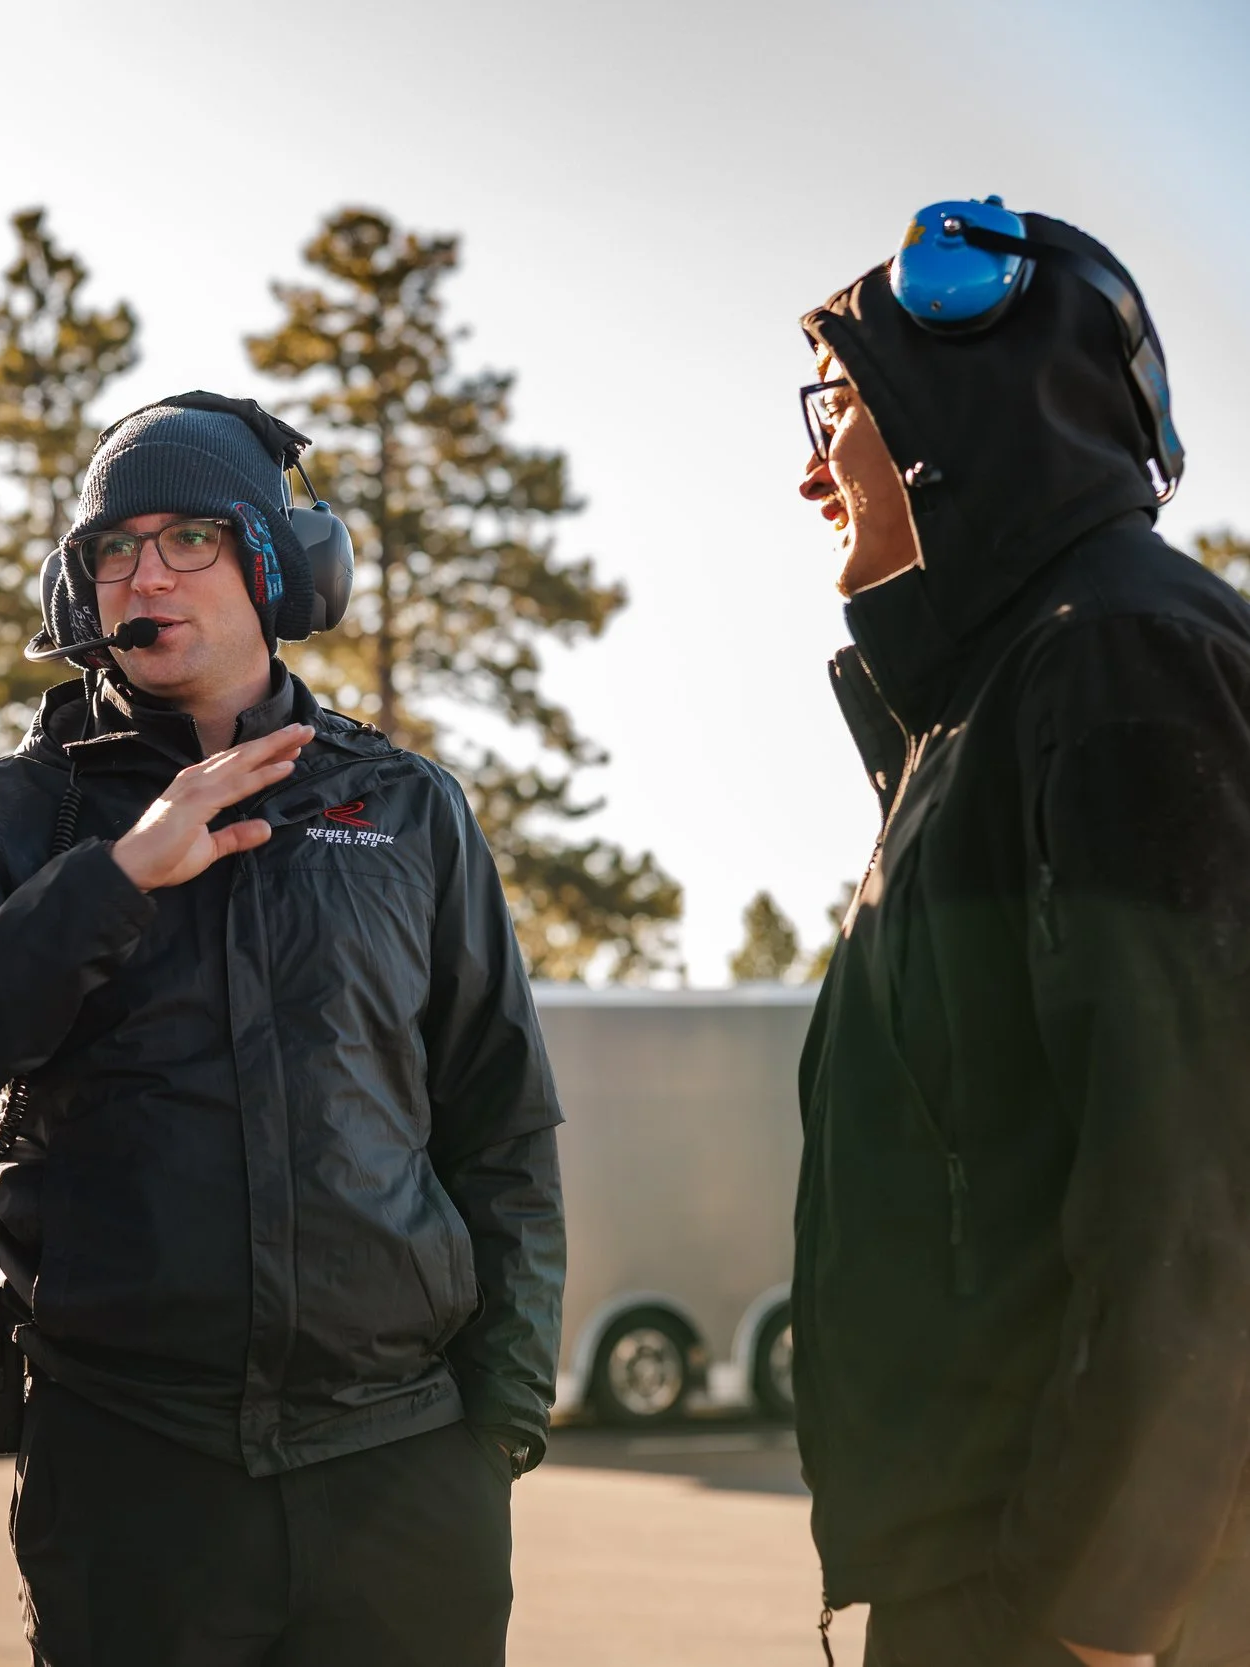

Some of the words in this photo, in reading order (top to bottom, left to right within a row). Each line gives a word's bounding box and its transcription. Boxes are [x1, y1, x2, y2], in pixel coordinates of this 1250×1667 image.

[305, 827, 351, 840] REBEL
[356, 831, 395, 845] ROCK
[326, 838, 378, 848] RACING
